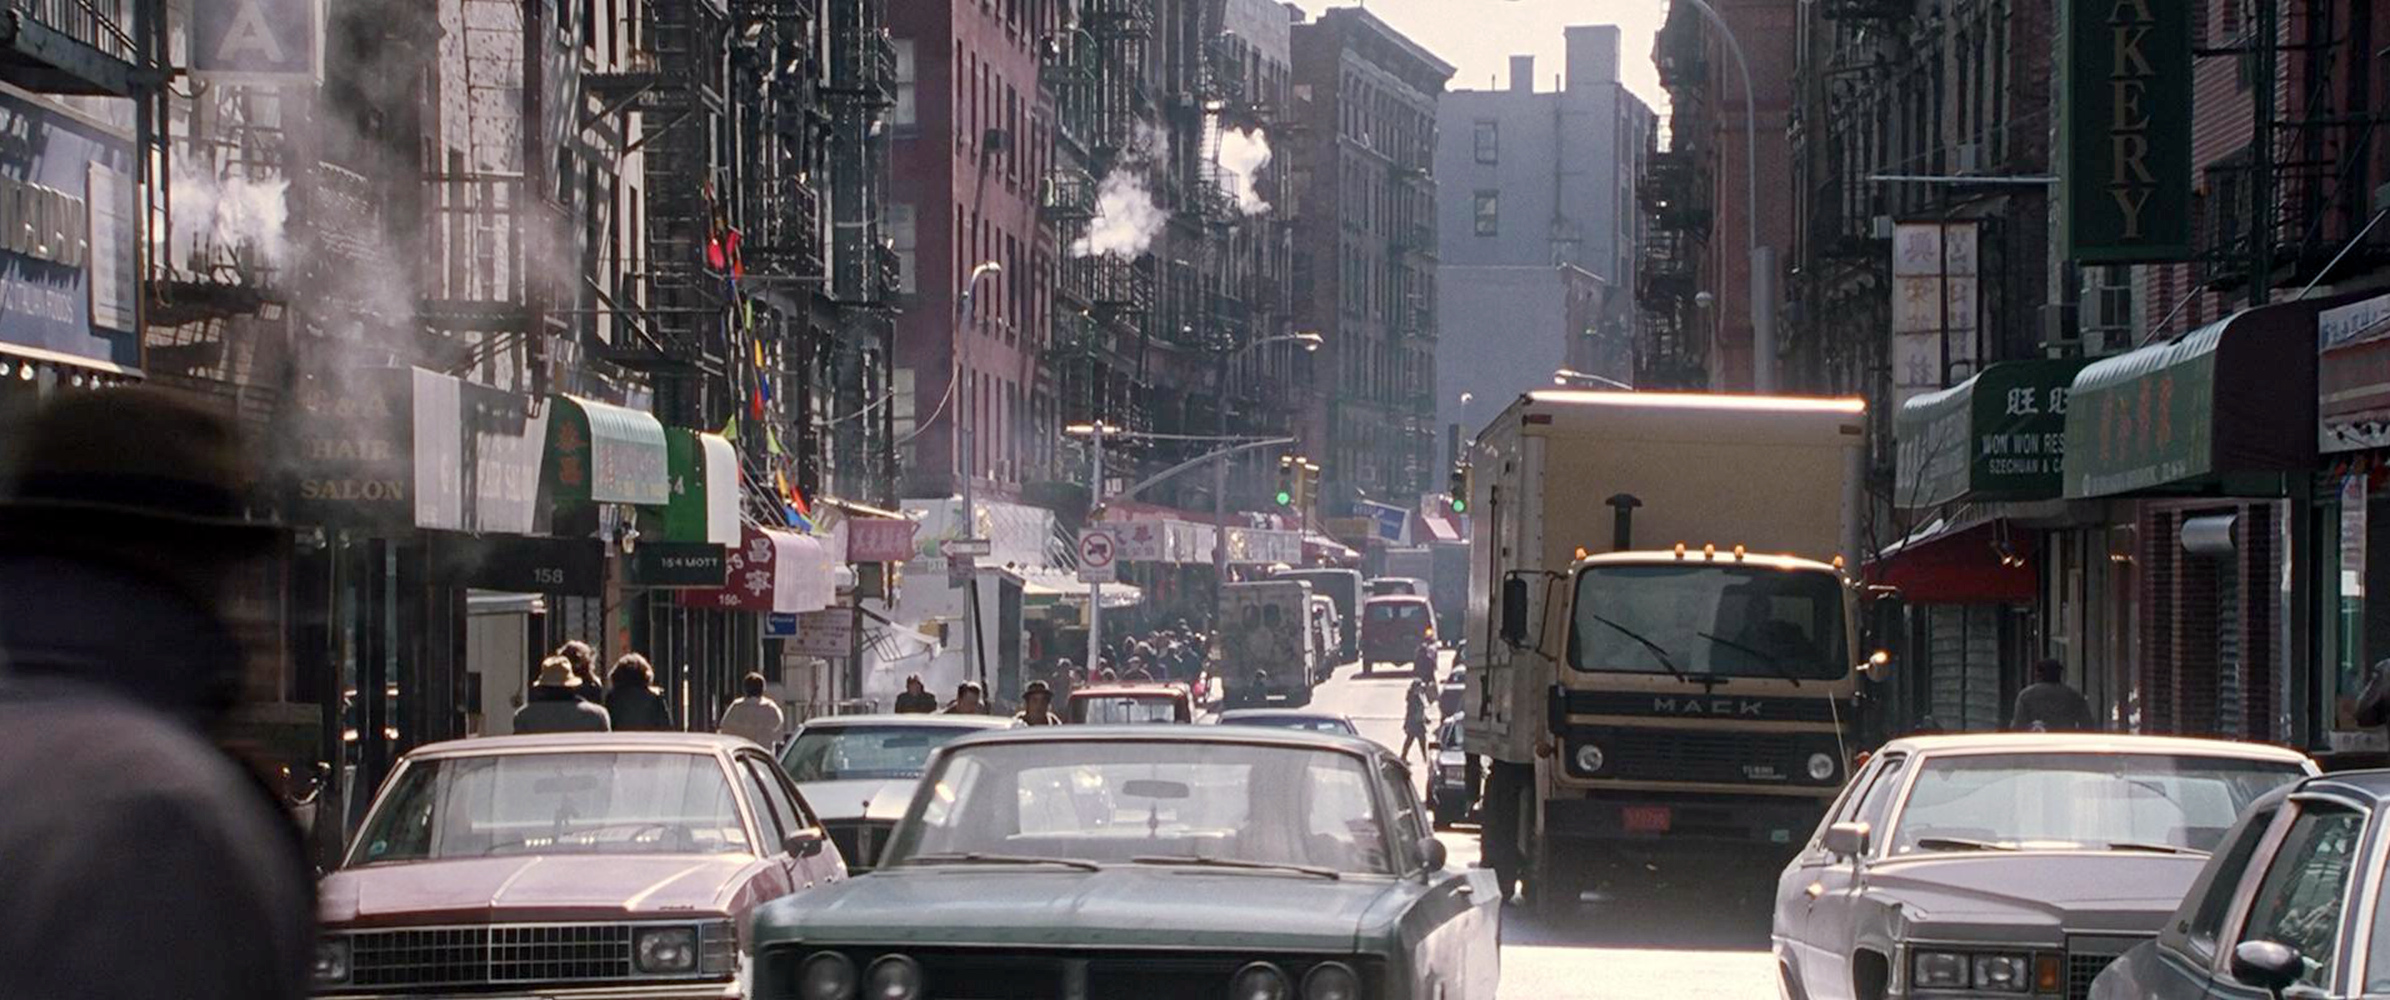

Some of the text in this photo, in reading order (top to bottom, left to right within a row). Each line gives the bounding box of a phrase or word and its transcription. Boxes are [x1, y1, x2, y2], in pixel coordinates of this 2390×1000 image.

[312, 439, 392, 461] HAIR
[1981, 433, 2009, 455] WON
[2013, 433, 2039, 454] WON
[300, 479, 404, 501] SALON
[684, 557, 718, 568] MOTT
[534, 568, 564, 584] 158
[1654, 697, 1762, 715] MACK
